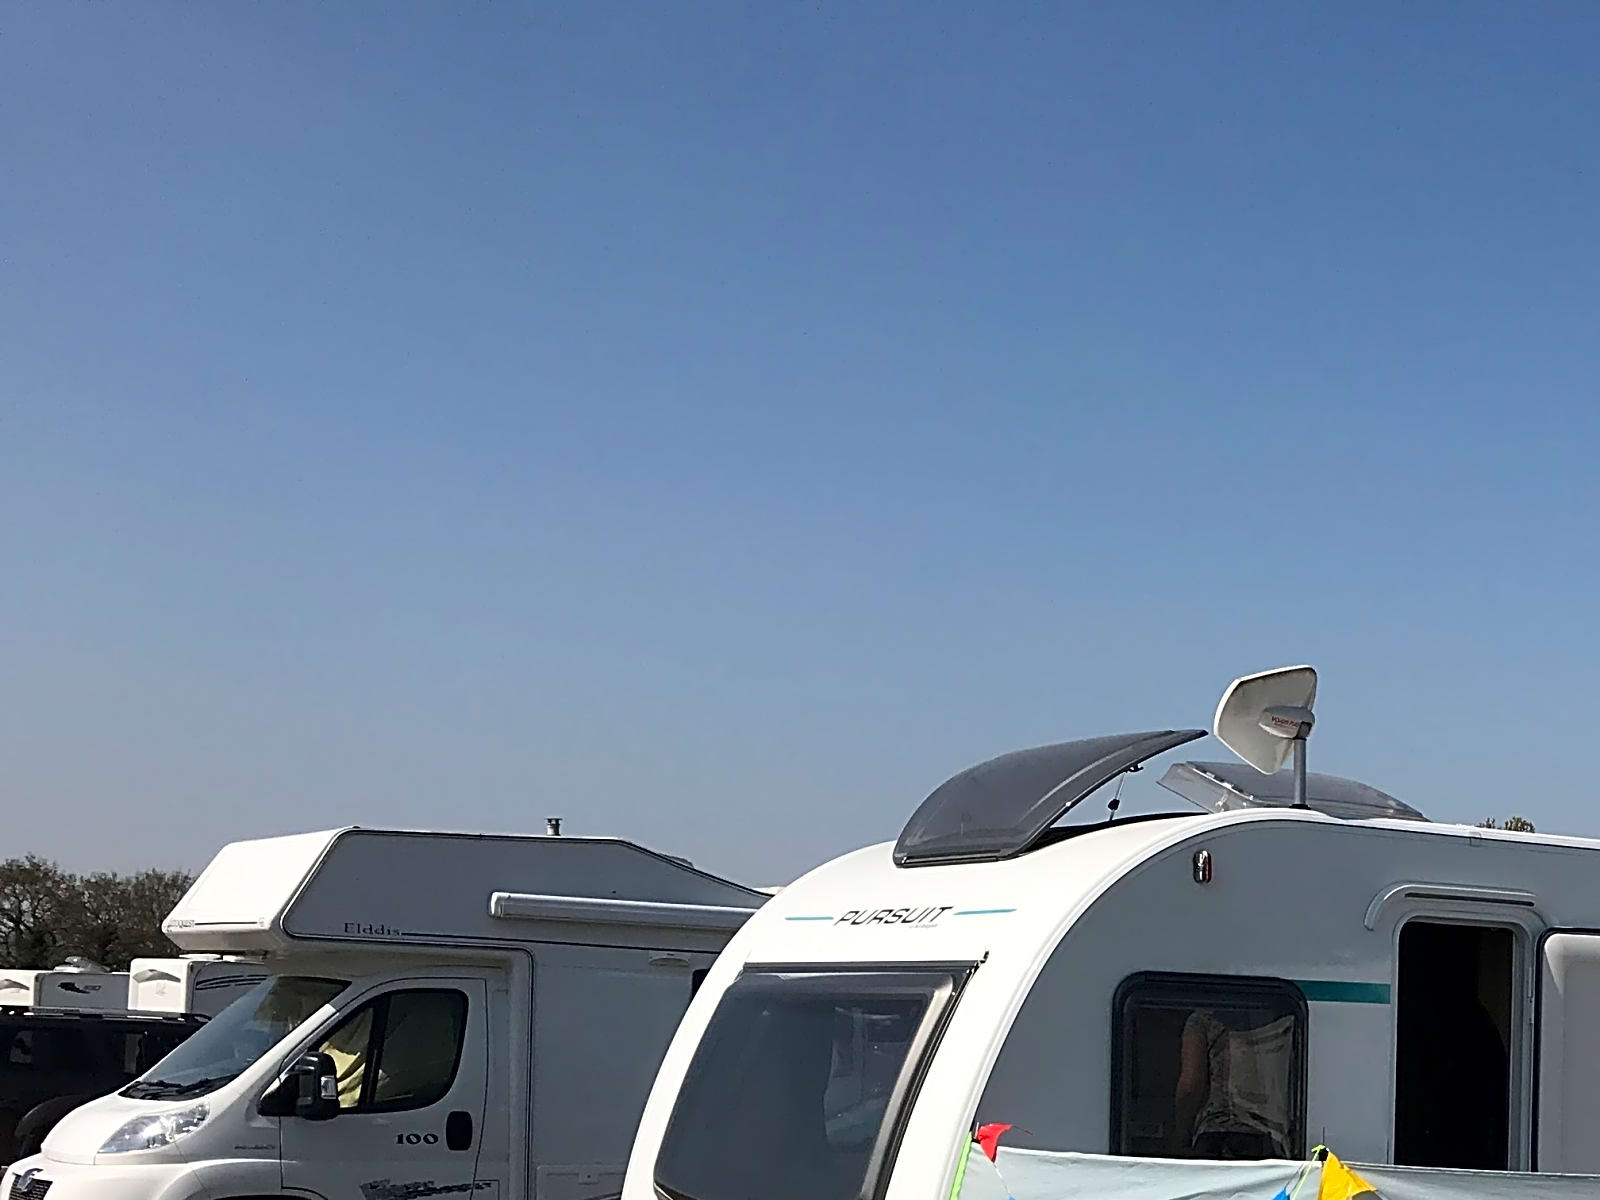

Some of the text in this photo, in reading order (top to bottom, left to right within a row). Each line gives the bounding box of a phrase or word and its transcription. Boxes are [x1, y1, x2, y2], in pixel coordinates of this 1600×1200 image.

[833, 905, 954, 926] PURSUIT
[344, 922, 400, 936] Elddis
[396, 1133, 439, 1145] 100
